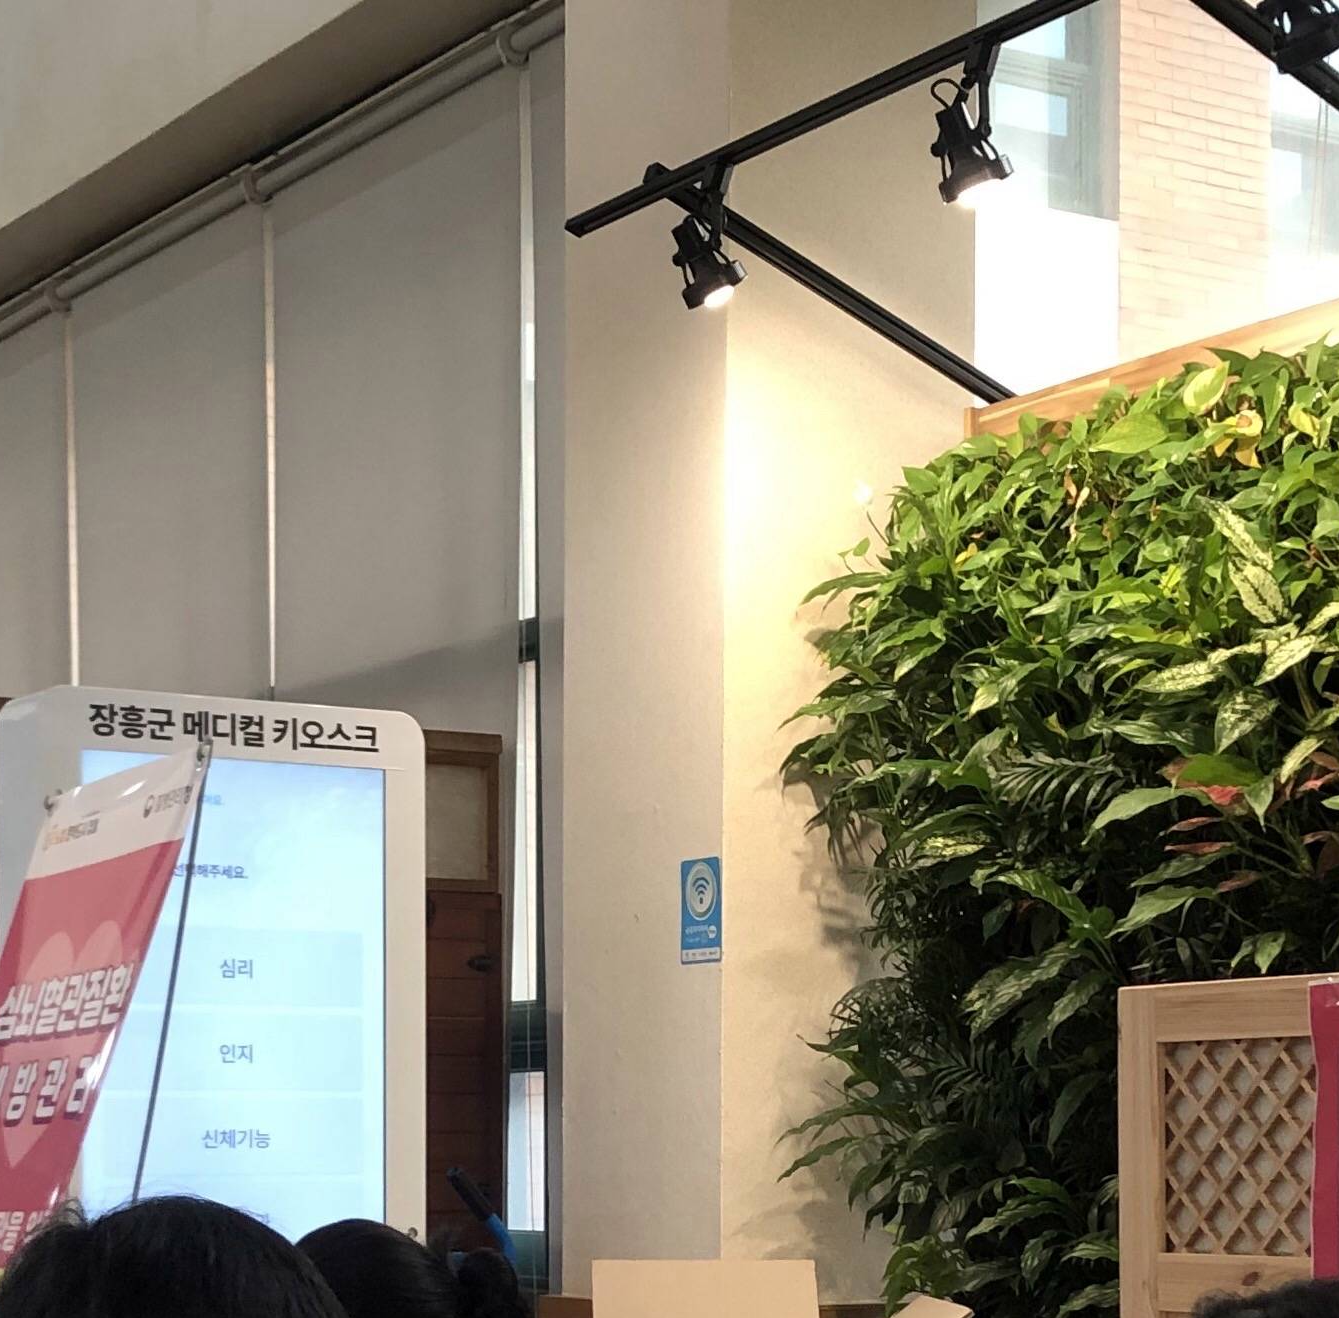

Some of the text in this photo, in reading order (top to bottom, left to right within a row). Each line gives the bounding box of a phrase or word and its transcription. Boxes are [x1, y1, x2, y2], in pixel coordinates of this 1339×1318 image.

[88, 703, 380, 753] 장흥군 메디컬 키오스크
[219, 958, 254, 979] 심리
[218, 1044, 254, 1065] 인지
[201, 1129, 272, 1150] 신체기능
